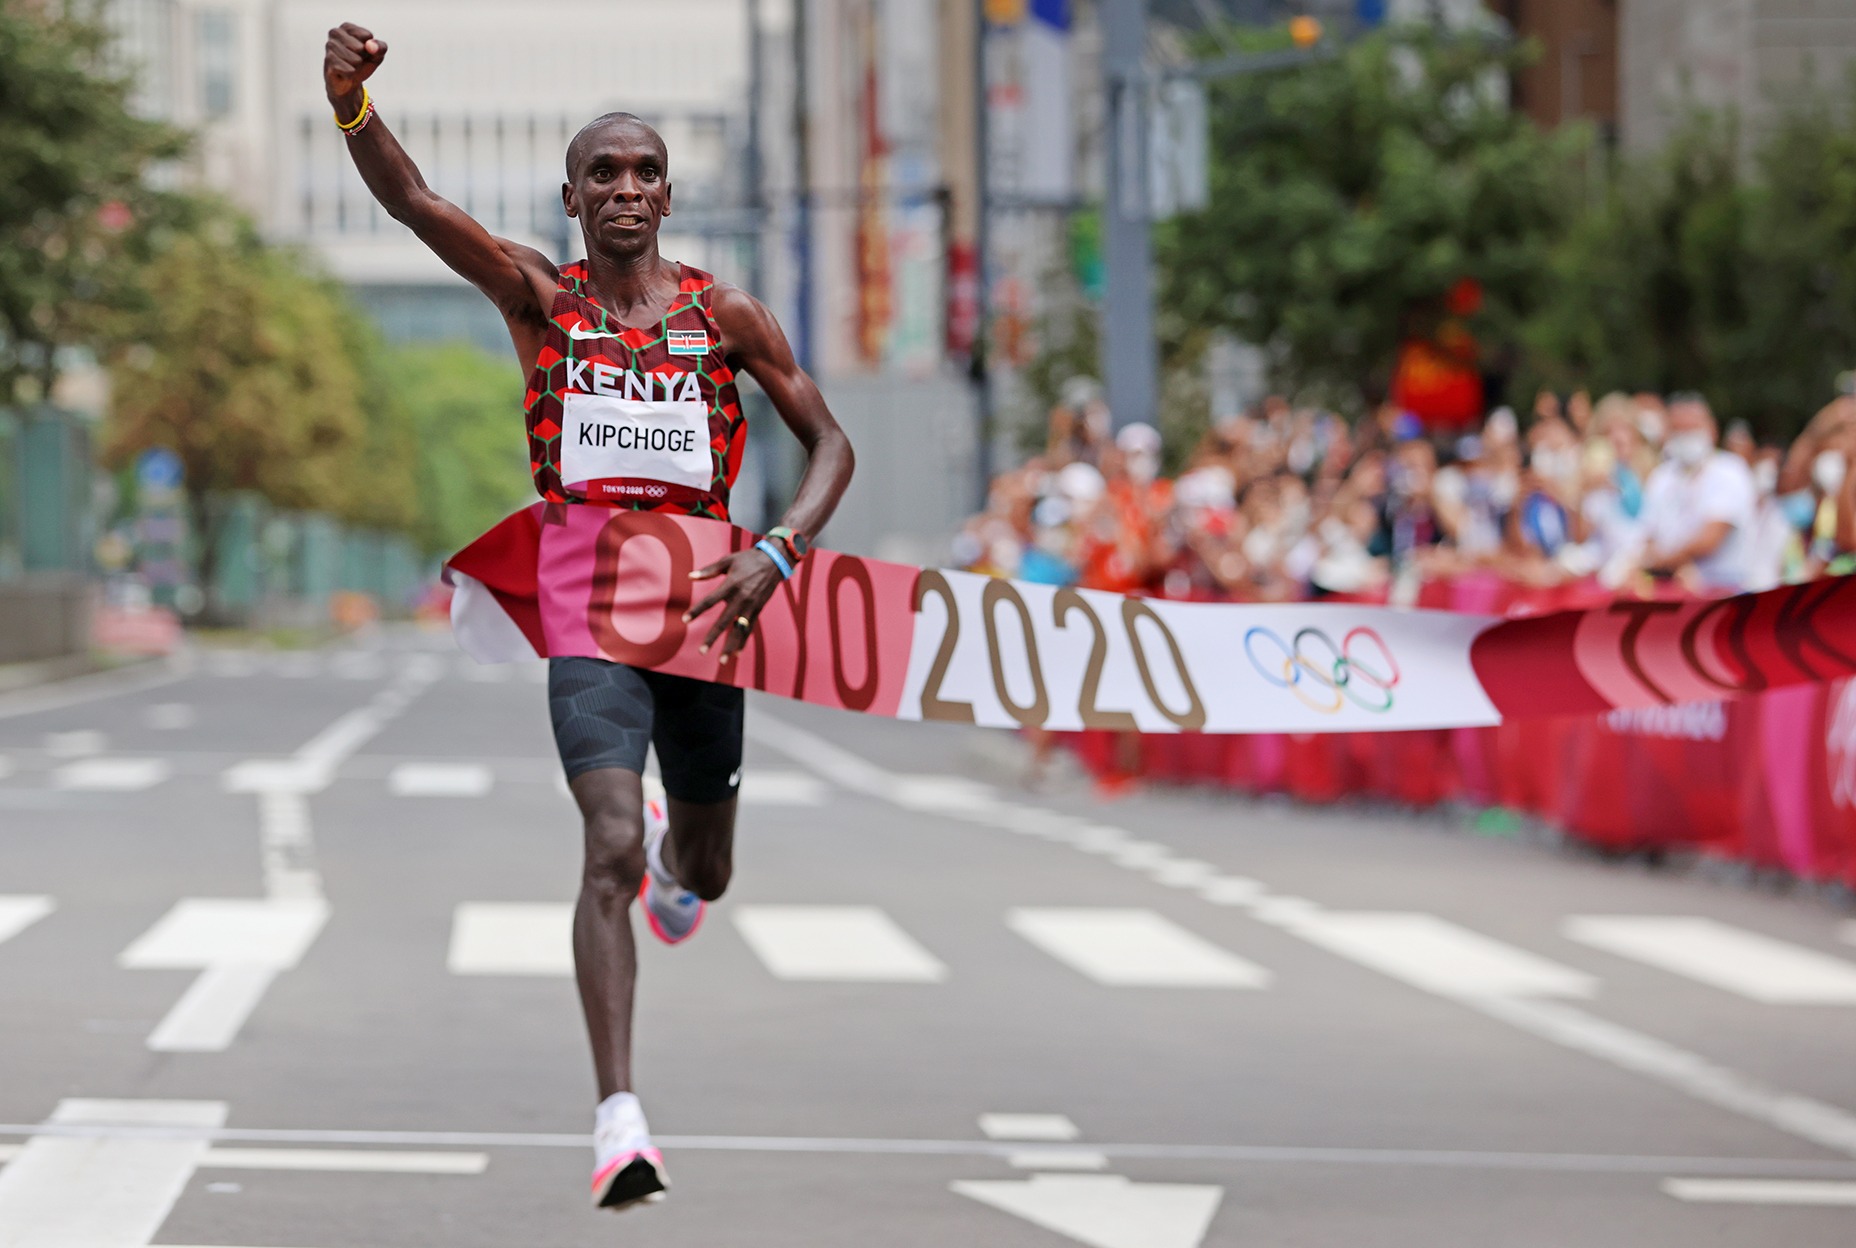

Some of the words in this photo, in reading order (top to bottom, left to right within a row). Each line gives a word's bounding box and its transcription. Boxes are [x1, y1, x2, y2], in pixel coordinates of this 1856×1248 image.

[566, 358, 702, 402] KENYA
[579, 423, 695, 452] KIPCHOGE
[602, 484, 625, 494] TOKYO
[626, 486, 644, 495] 2020
[544, 503, 878, 712] OYO
[911, 569, 1206, 731] 2020
